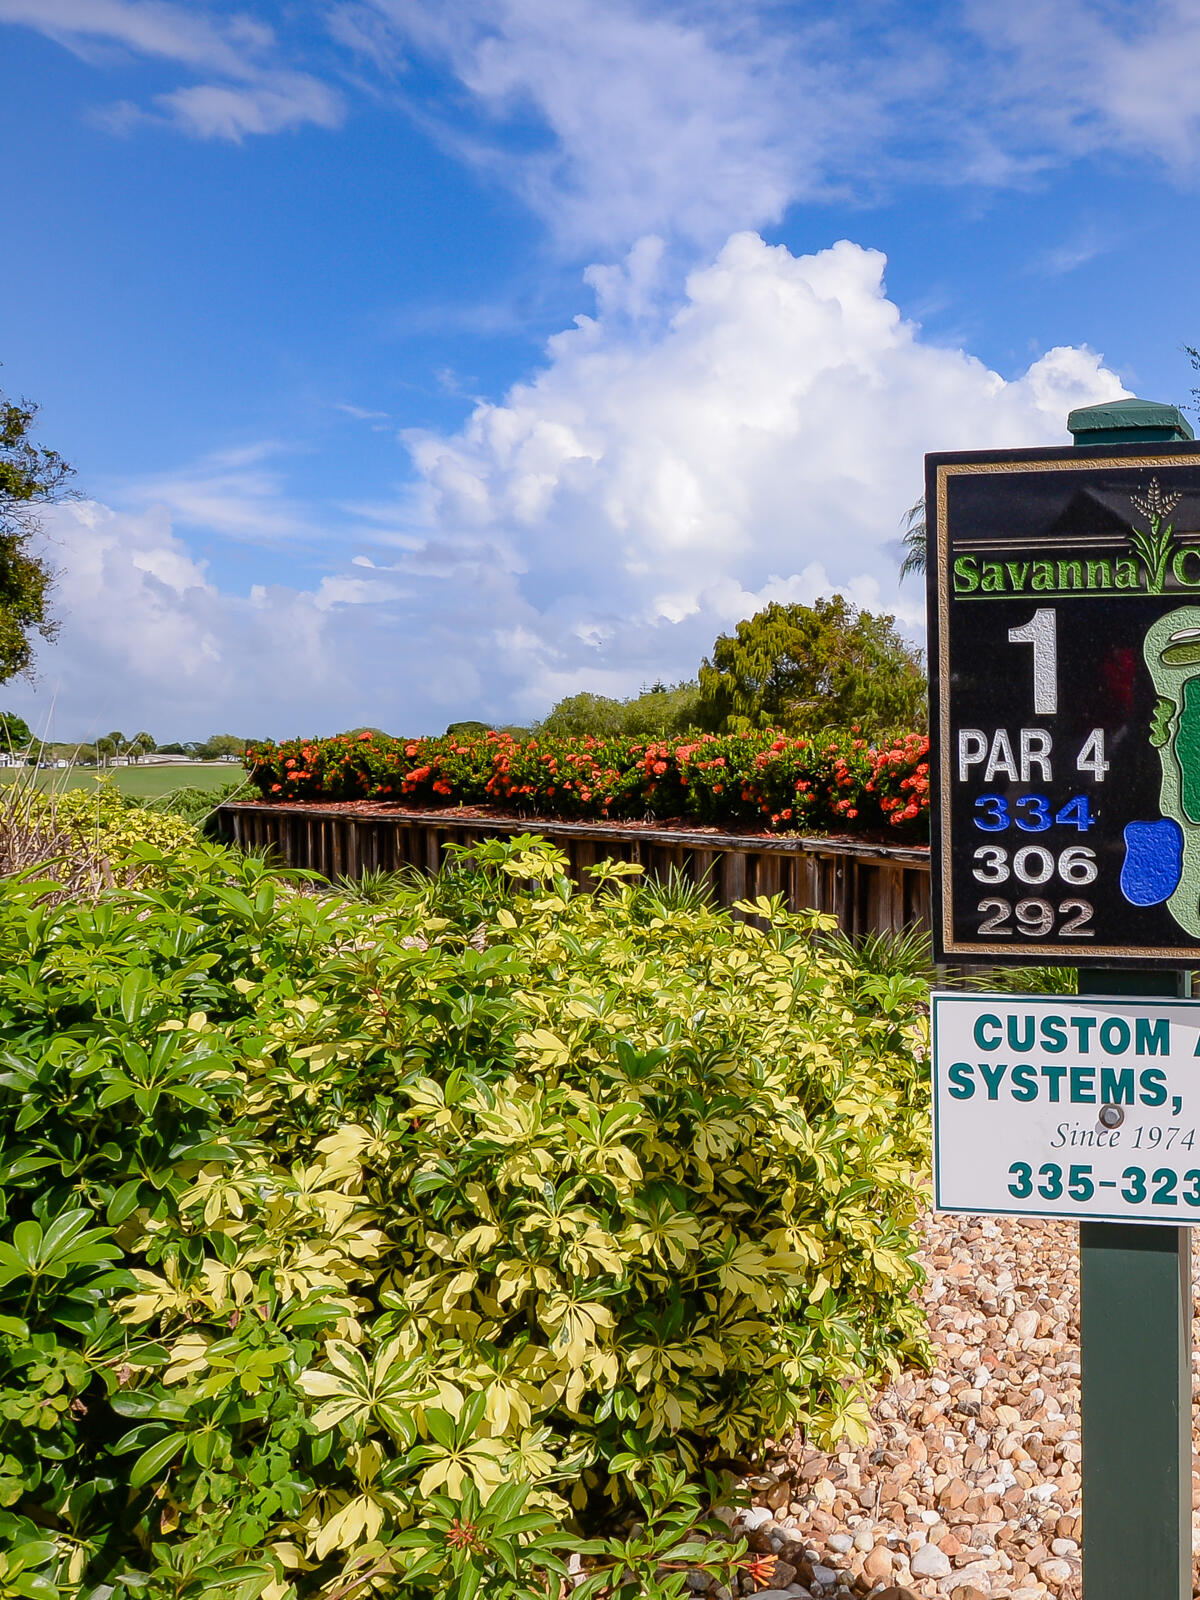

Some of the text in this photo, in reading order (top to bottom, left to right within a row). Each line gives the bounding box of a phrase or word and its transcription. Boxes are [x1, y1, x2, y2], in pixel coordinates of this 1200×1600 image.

[953, 553, 1141, 593] Savanna
[1008, 608, 1057, 715] 1
[958, 728, 1110, 782] PAR 4
[973, 793, 1096, 833] 334
[972, 846, 1099, 885] 306
[977, 897, 1095, 937] 292
[973, 1013, 1170, 1057] CUSTOM
[948, 1062, 1183, 1116] SYSTEMS,
[1050, 1122, 1196, 1151] Since 1974
